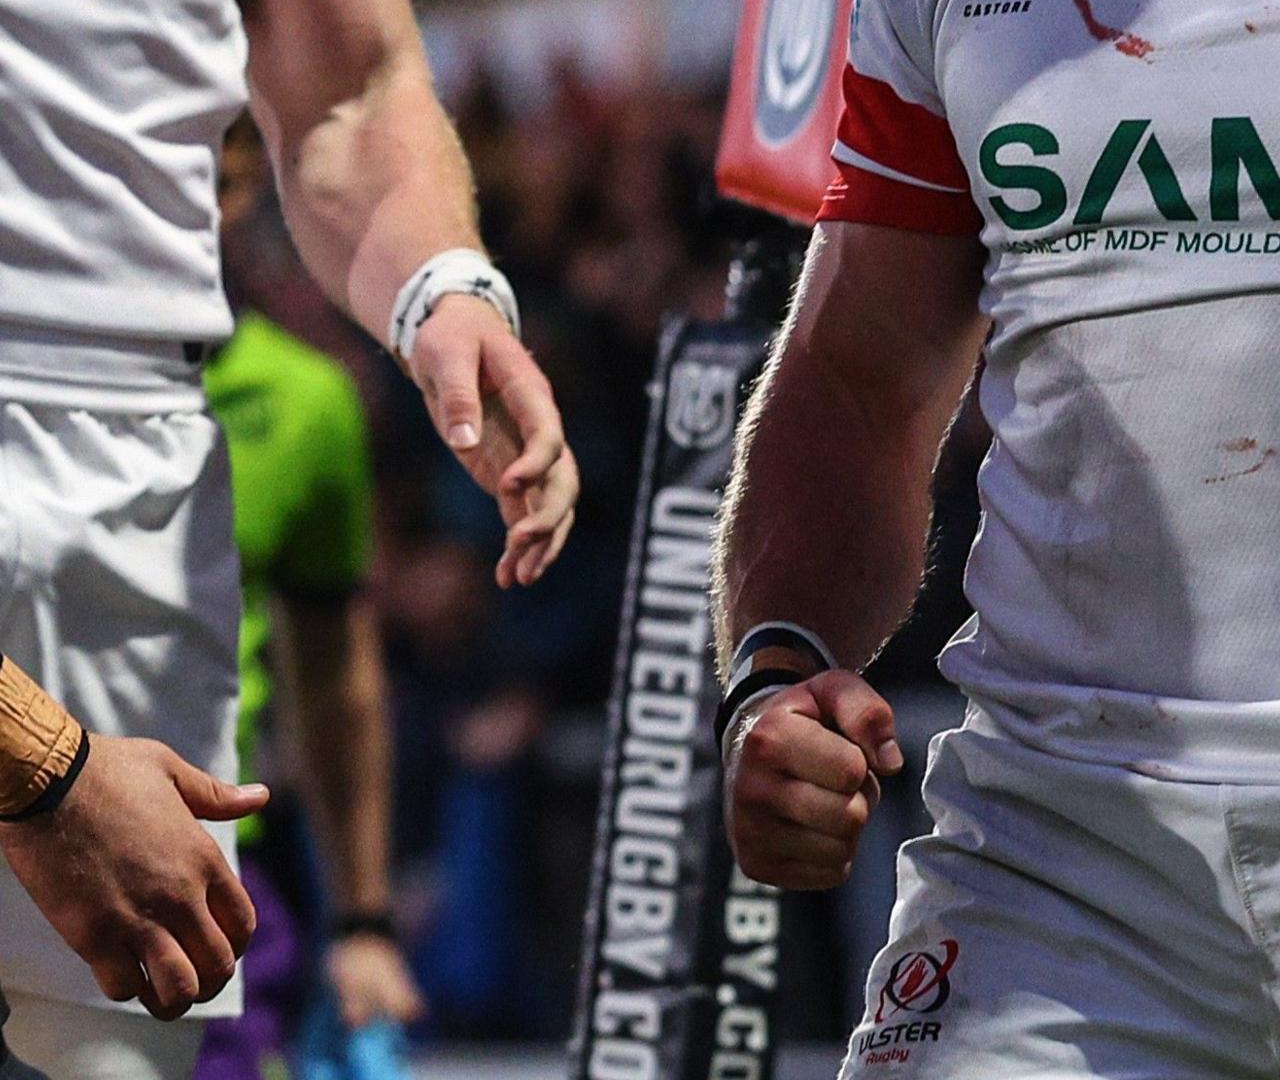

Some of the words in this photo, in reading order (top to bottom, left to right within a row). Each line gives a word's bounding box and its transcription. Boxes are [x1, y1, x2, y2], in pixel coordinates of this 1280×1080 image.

[963, 0, 1032, 18] CASTORE
[1065, 230, 1098, 252] OF
[1105, 229, 1169, 252] MDF
[859, 1021, 942, 1056] ULSTER
